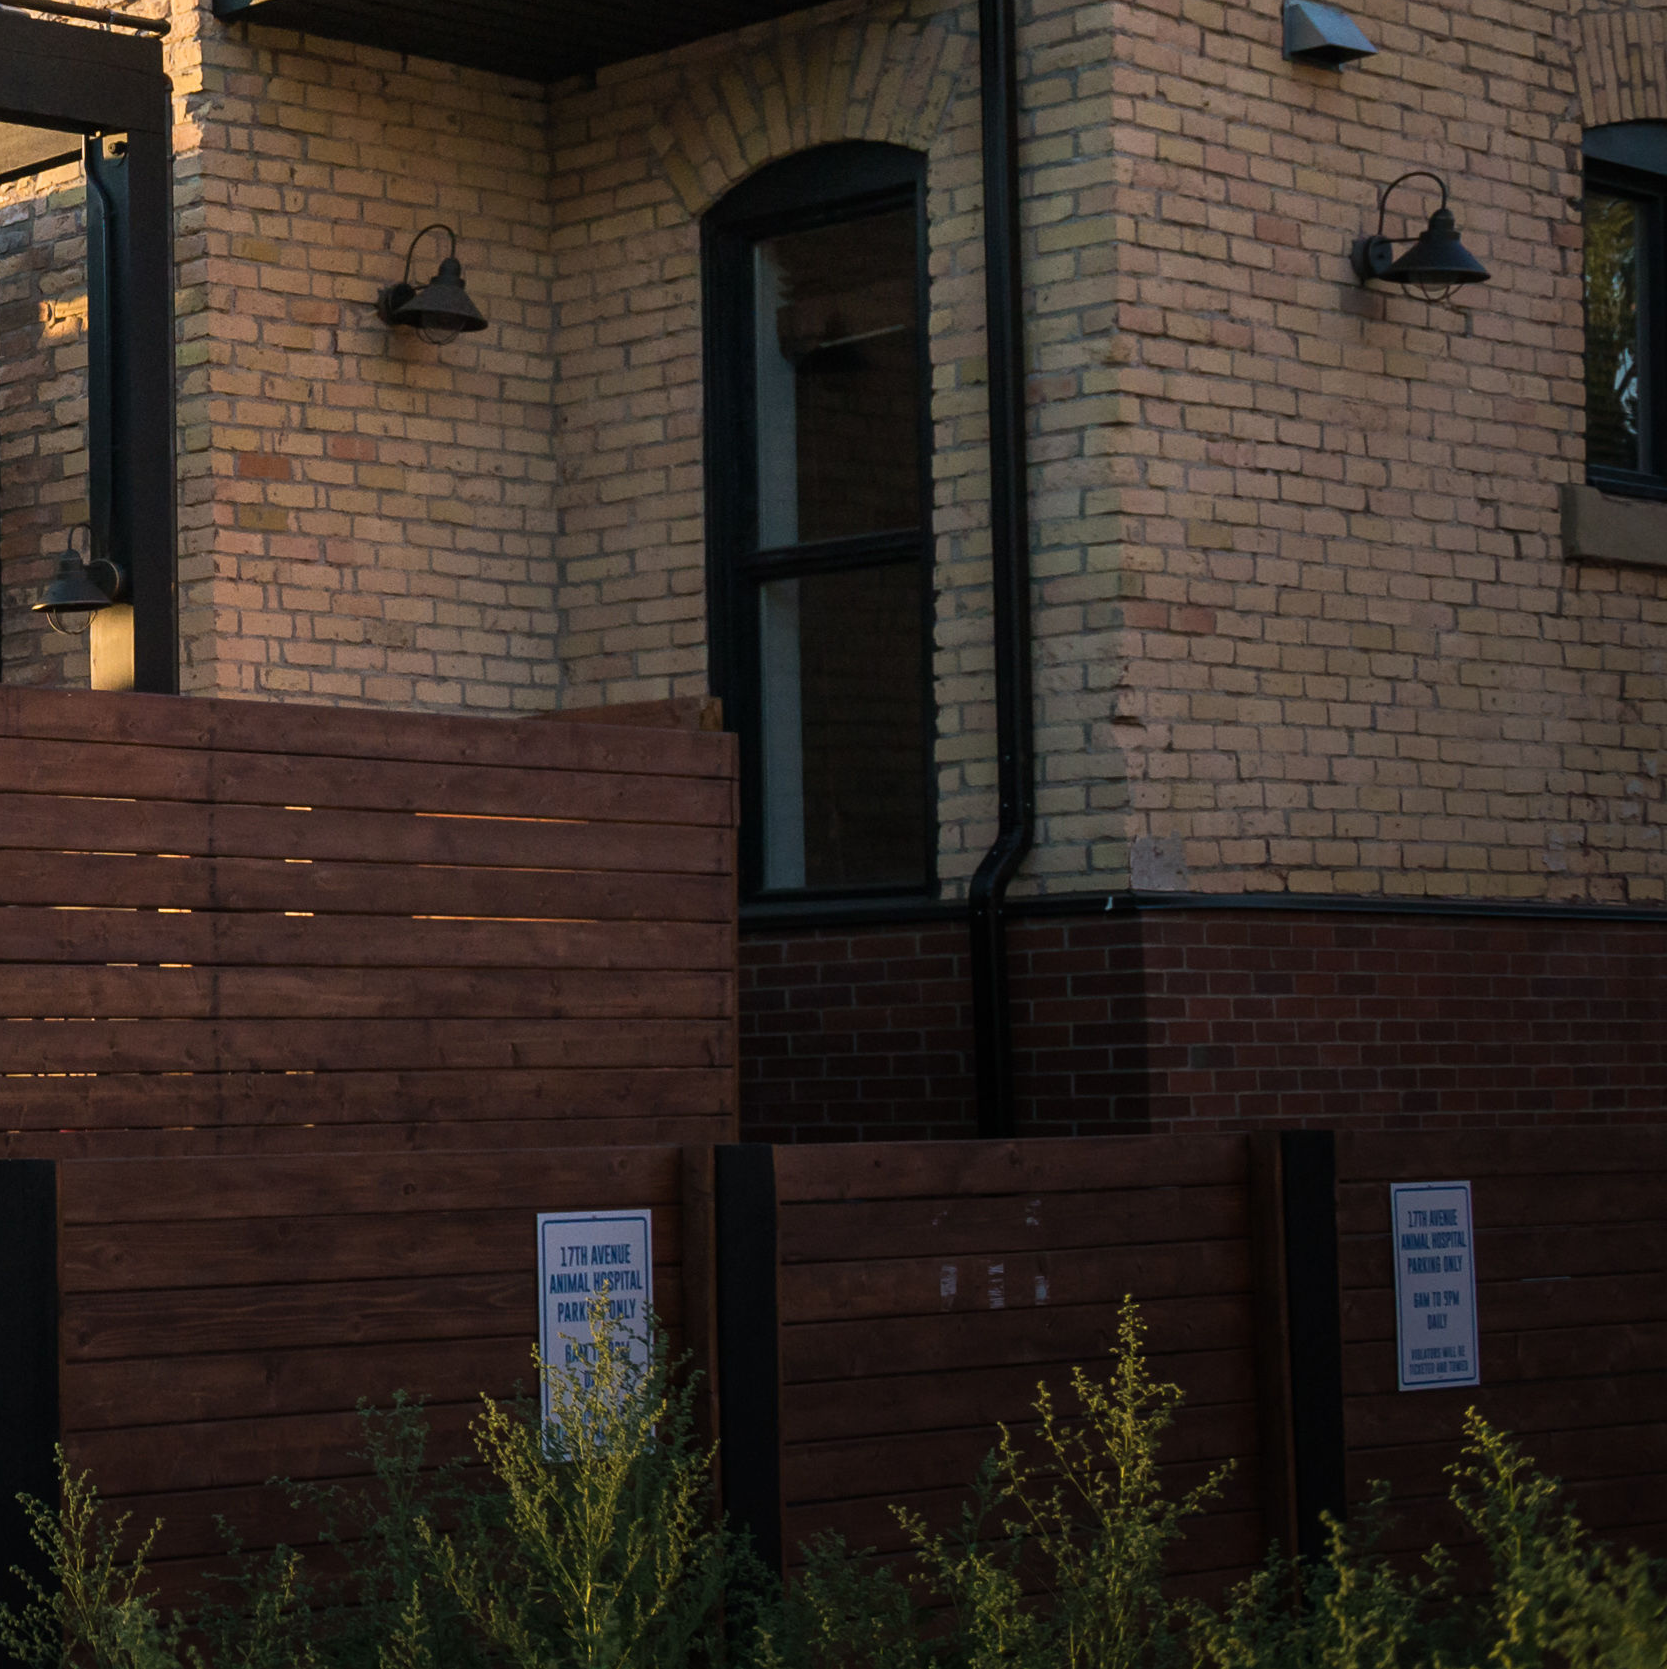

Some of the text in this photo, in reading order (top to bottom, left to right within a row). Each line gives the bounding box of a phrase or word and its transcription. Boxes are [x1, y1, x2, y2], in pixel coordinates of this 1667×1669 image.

[1408, 1208, 1458, 1228] 17TH AVENUE
[1401, 1231, 1467, 1250] ANIMAL HOSPITAL
[560, 1243, 631, 1268] 17TH AVENUE
[1407, 1254, 1463, 1275] PARKING ONLY
[549, 1273, 591, 1294] ANIMAL
[1432, 1291, 1442, 1308] TO
[1427, 1313, 1448, 1331] DAILY
